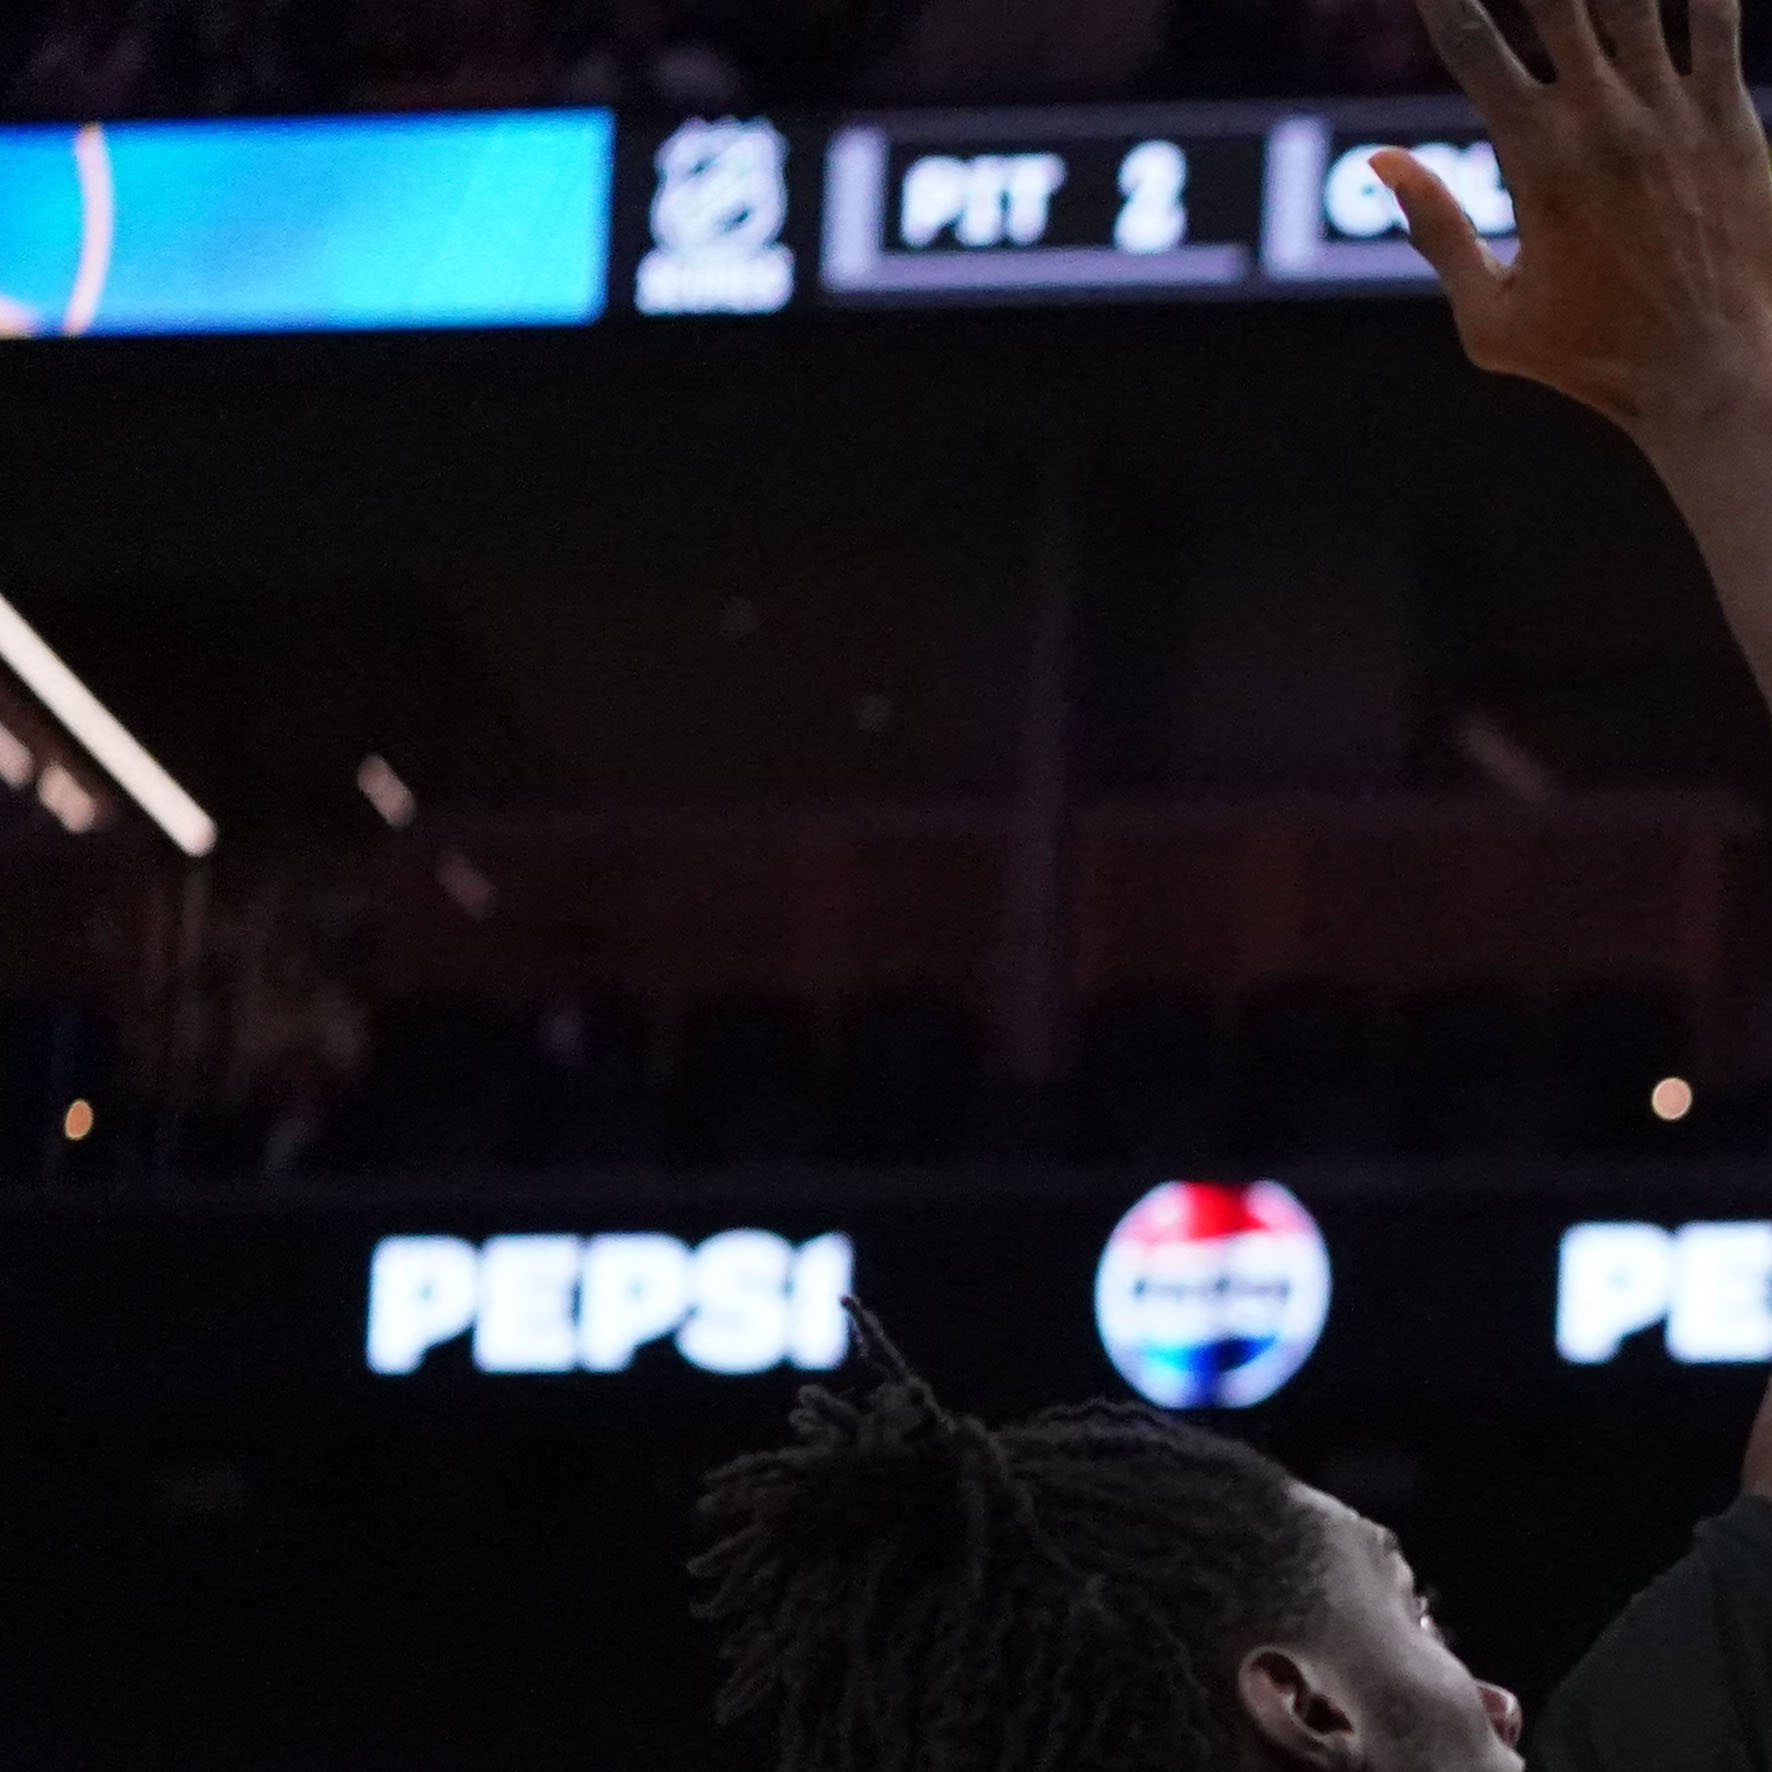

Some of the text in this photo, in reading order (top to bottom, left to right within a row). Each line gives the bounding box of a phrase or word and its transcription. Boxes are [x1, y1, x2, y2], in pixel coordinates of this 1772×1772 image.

[902, 154, 1067, 248] PIT
[1113, 139, 1188, 254] 2
[366, 1226, 855, 1376] PEPSI
